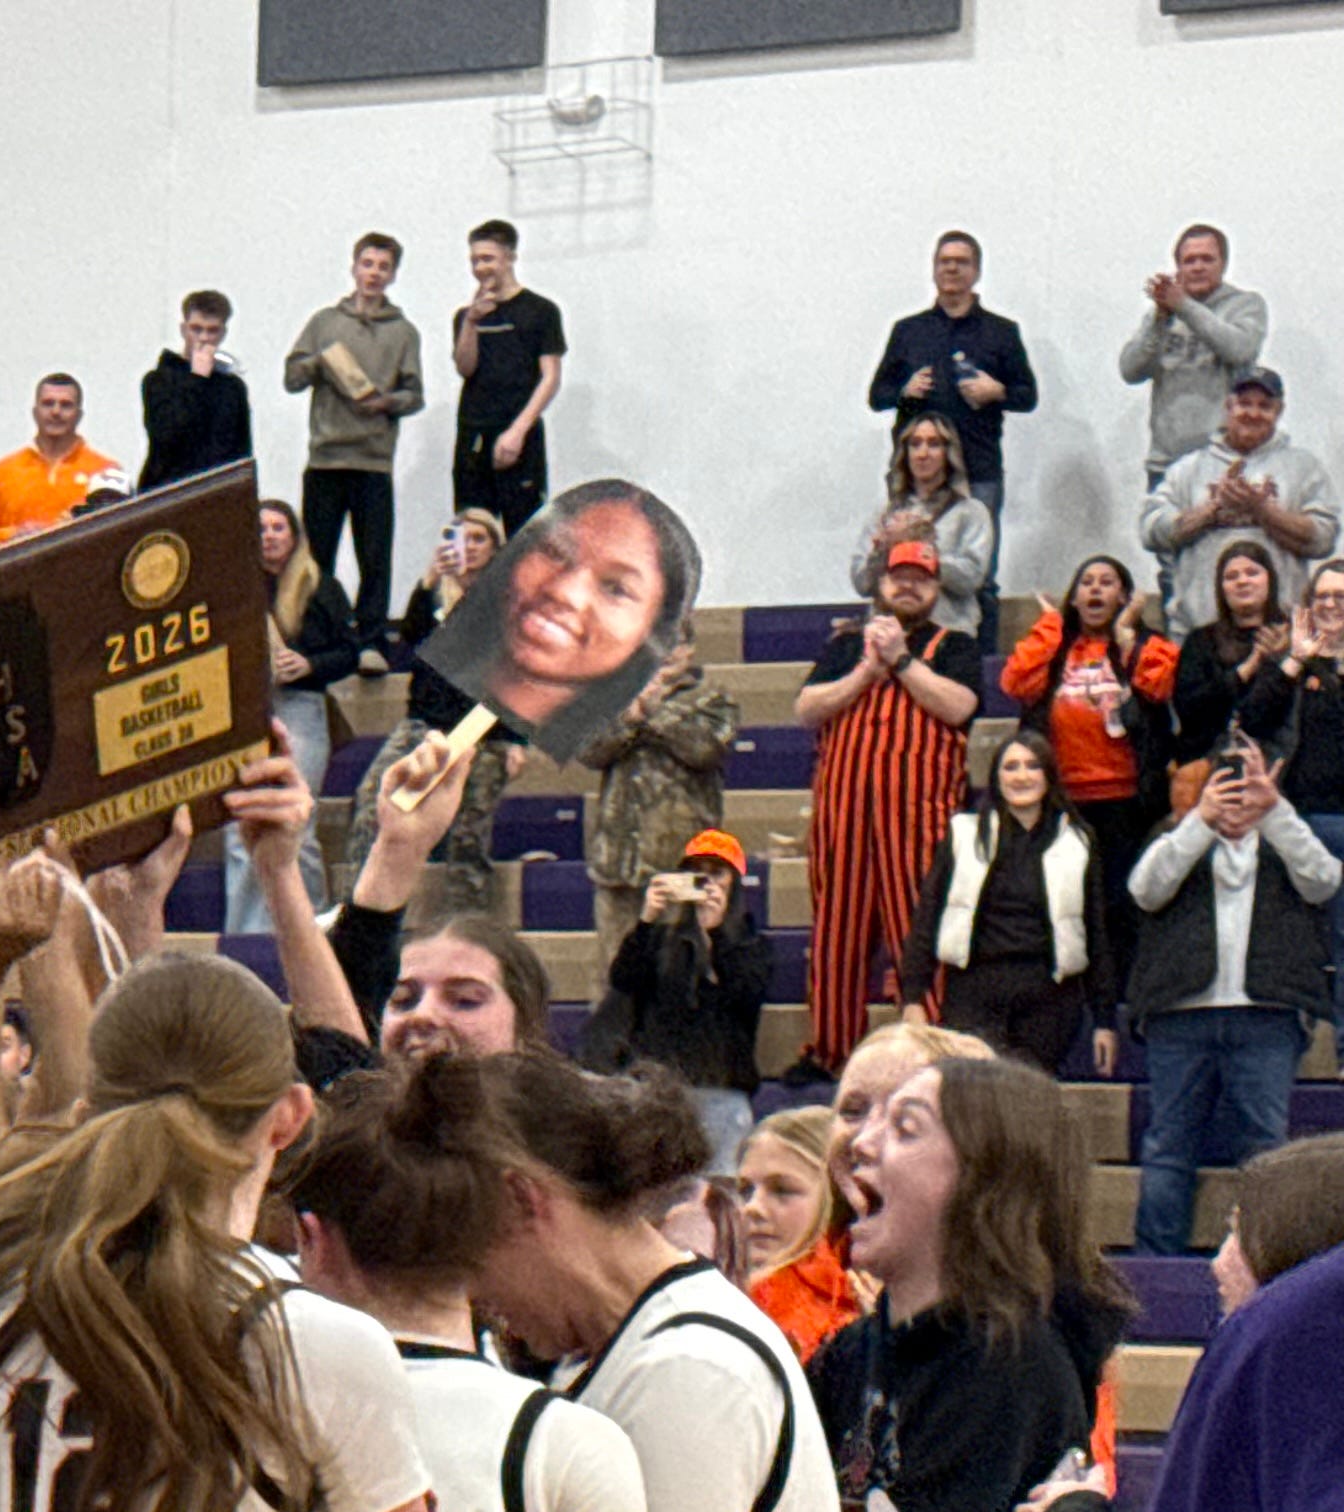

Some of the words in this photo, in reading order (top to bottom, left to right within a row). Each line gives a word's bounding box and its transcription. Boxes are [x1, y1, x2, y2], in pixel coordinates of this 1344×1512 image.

[105, 602, 211, 674] 2026
[118, 688, 205, 738] BASKETBALL
[140, 671, 181, 705] GIRLS
